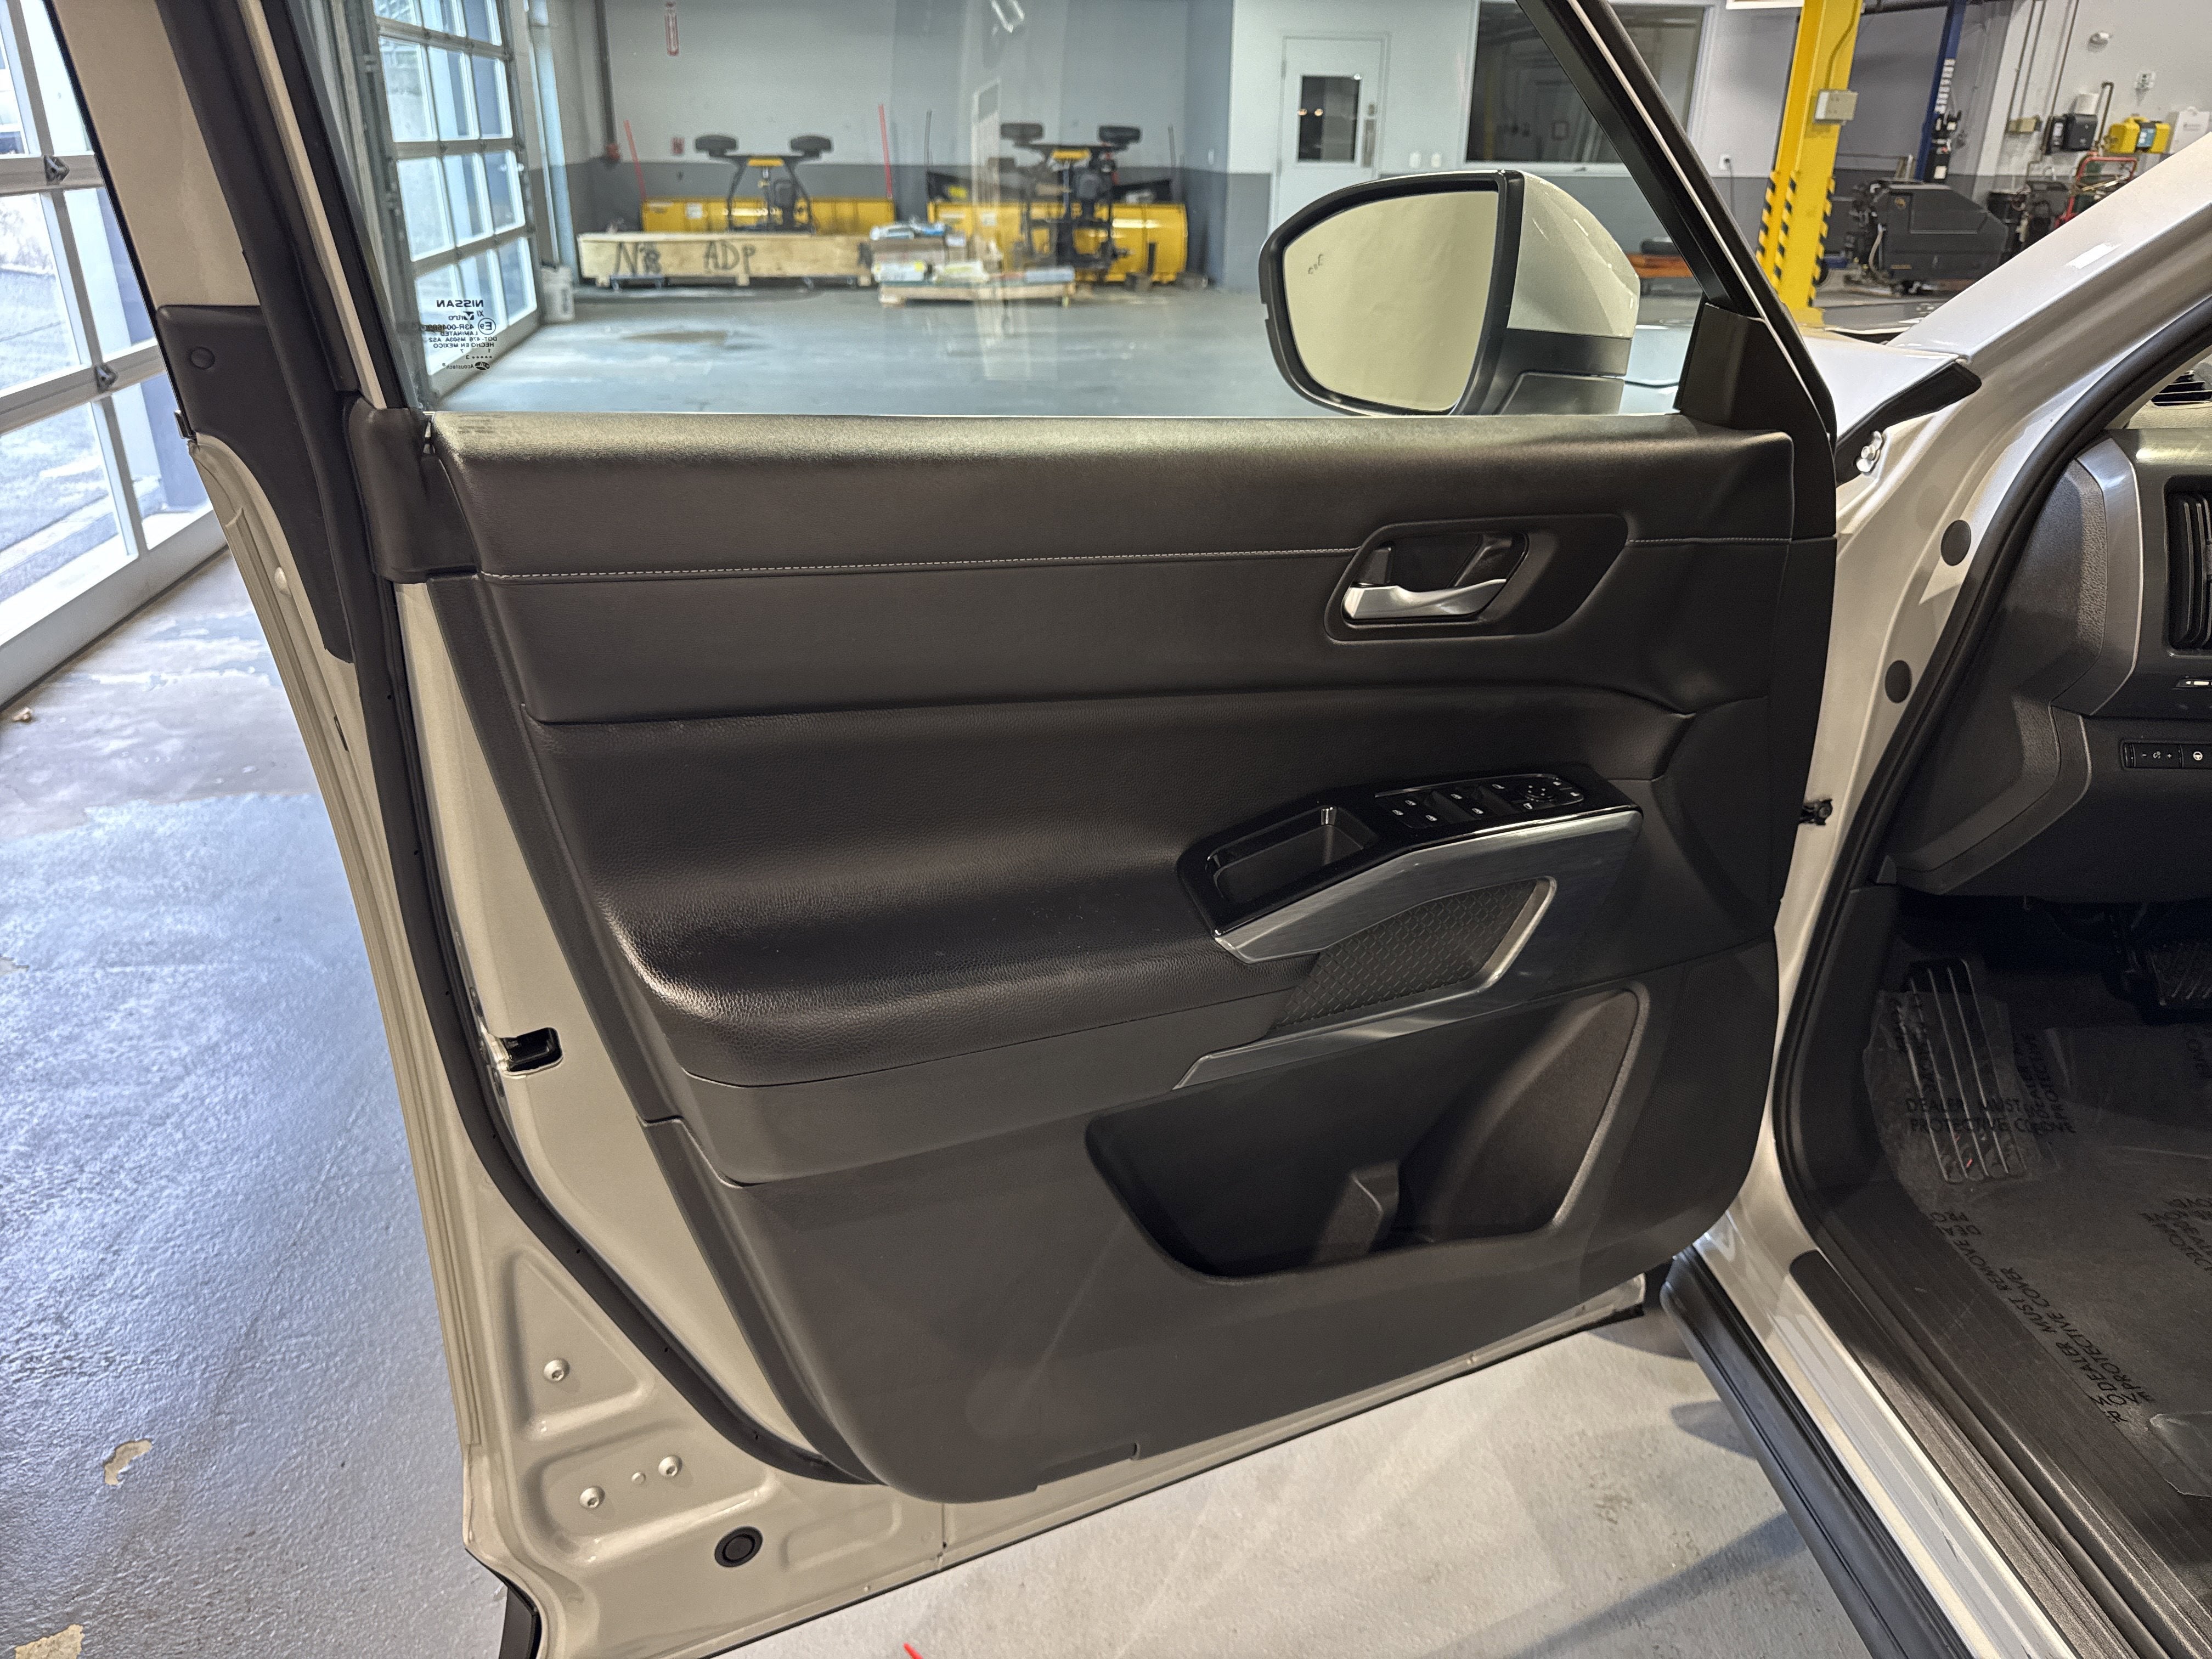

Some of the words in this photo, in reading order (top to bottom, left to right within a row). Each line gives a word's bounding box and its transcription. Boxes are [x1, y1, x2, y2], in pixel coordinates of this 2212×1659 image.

[1954, 1239, 2012, 1292] REMOVE
[2000, 1266, 2050, 1309] COVER
[2008, 1295, 2058, 1335] MUST
[2047, 1311, 2142, 1390] PROTECTIVE
[2056, 1341, 2118, 1392] DEALER
